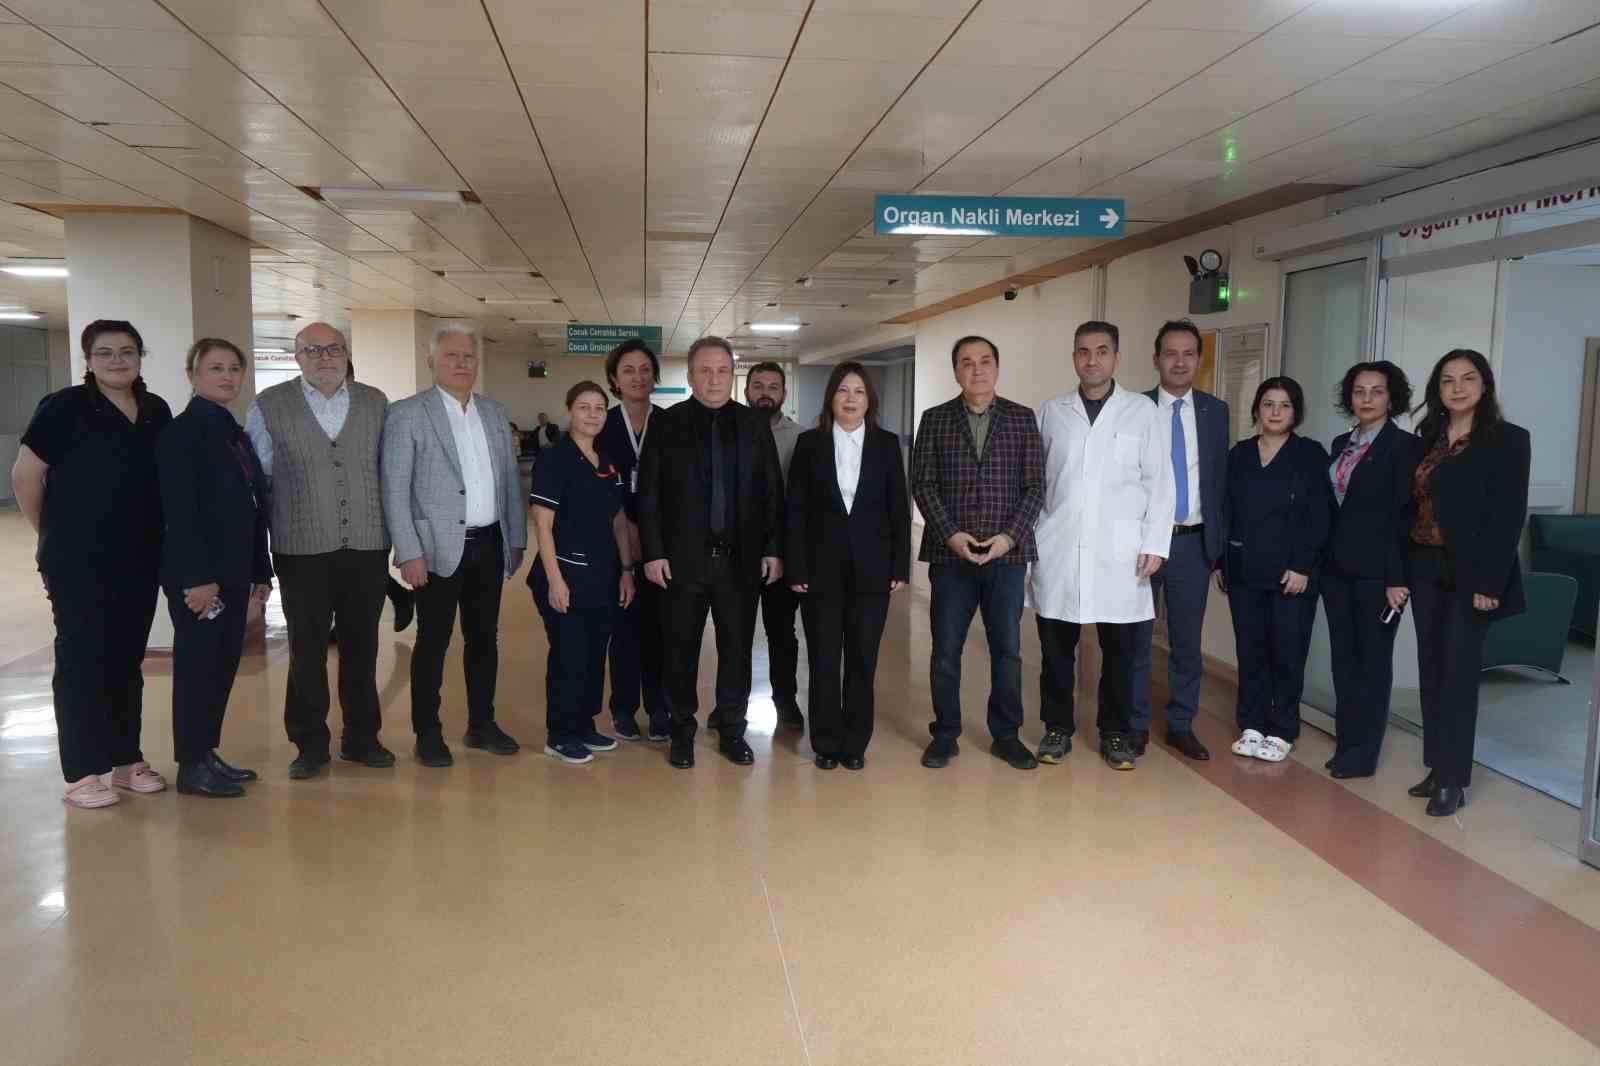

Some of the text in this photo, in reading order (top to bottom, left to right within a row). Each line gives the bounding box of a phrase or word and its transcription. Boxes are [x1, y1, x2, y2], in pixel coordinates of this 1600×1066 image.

[883, 206, 1080, 228] Organ Nakli Merkezi
